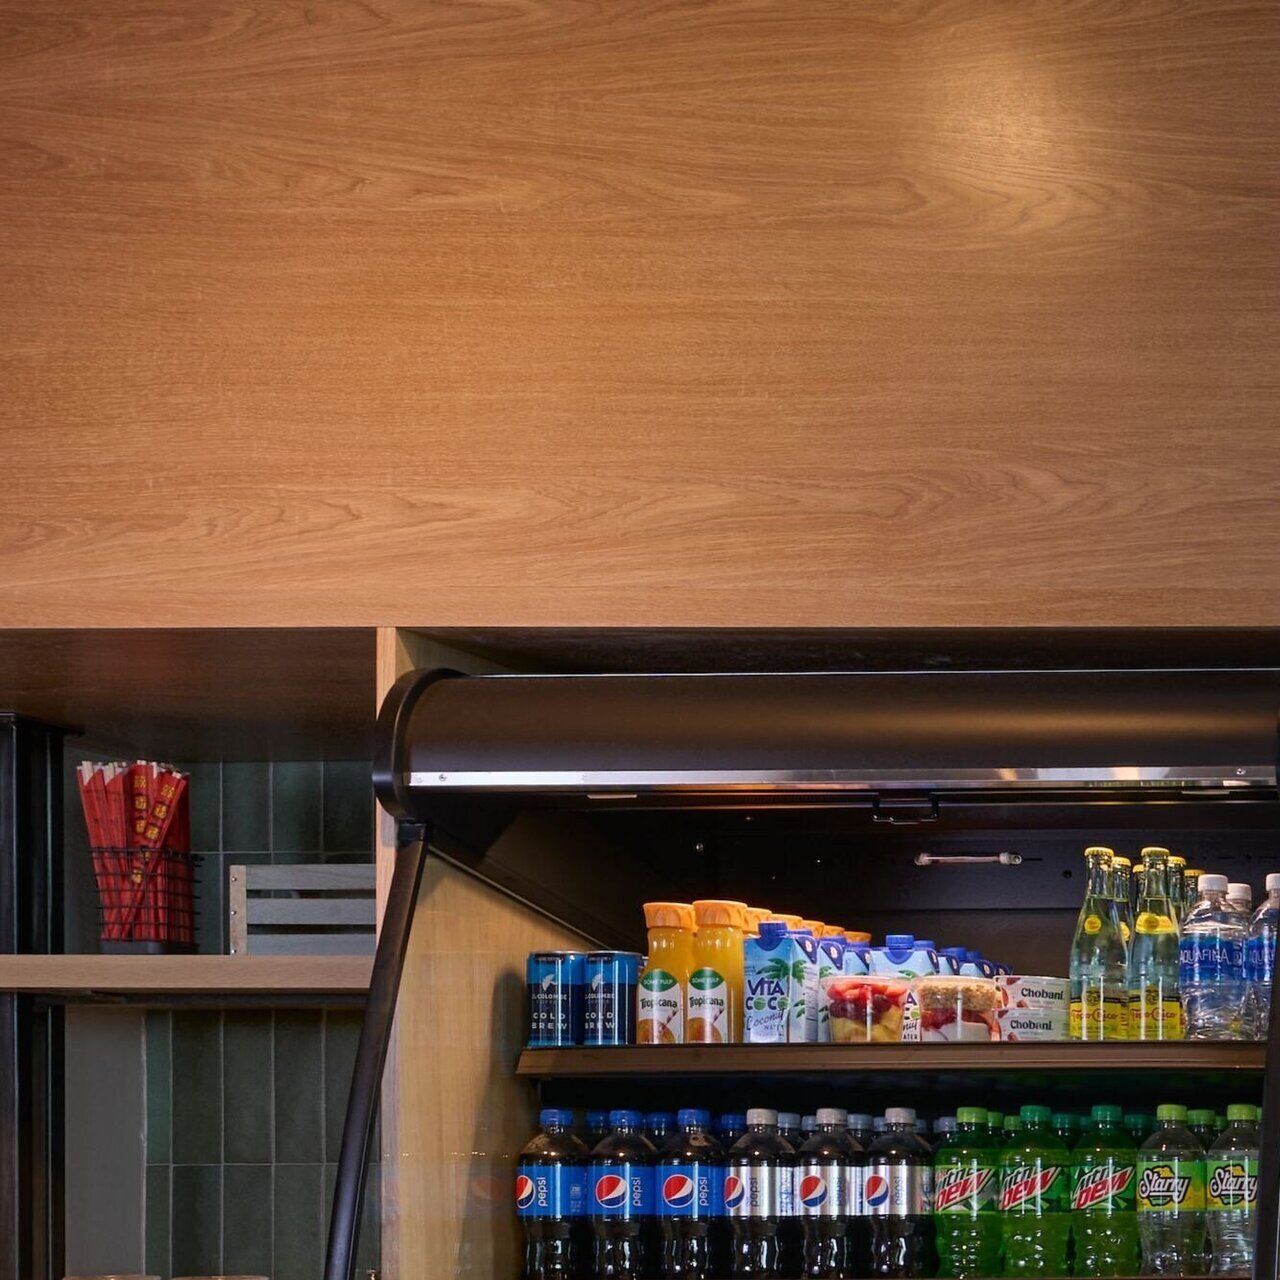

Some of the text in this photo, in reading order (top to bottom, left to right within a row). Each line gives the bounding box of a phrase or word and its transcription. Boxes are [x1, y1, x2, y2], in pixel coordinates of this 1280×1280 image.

[1179, 947, 1229, 966] AQUAFINA
[747, 979, 784, 996] VITA
[1020, 987, 1064, 1000] Chobani
[640, 997, 678, 1009] Tropicana
[689, 996, 724, 1008] Tropicana
[745, 996, 789, 1010] COCO
[533, 1012, 566, 1020] COLD
[585, 1011, 614, 1020] COLD
[531, 1022, 568, 1030] BREW
[585, 1022, 616, 1030] BREW
[1010, 1019, 1052, 1031] Chobani
[536, 1176, 549, 1207] pepsi
[632, 1176, 642, 1207] pepsi
[699, 1176, 708, 1207] pepsi
[749, 1177, 760, 1208] pepsi
[1139, 1169, 1190, 1204] Starry
[1210, 1168, 1258, 1203] Starry
